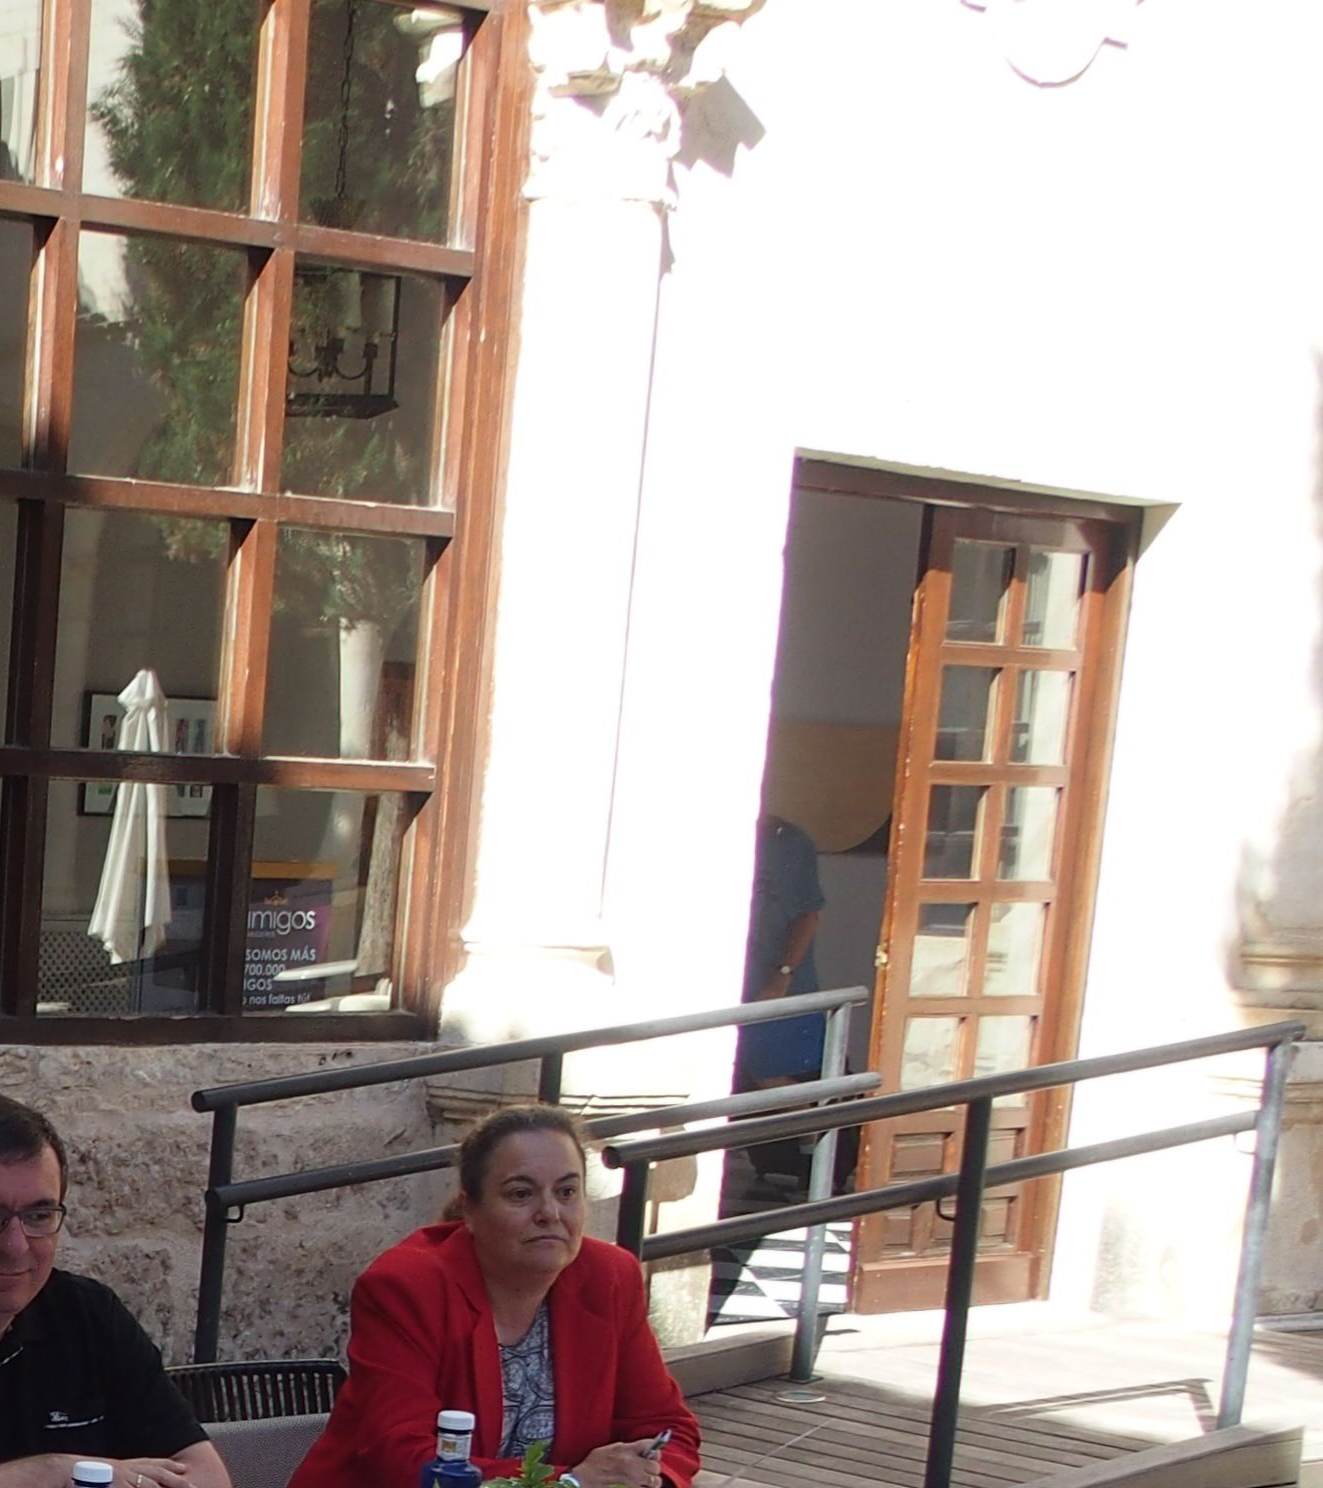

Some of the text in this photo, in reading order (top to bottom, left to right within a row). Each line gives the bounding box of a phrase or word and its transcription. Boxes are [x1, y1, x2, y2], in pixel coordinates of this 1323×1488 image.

[245, 945, 316, 961] SOMOS MÁS
[249, 995, 266, 1005] nos
